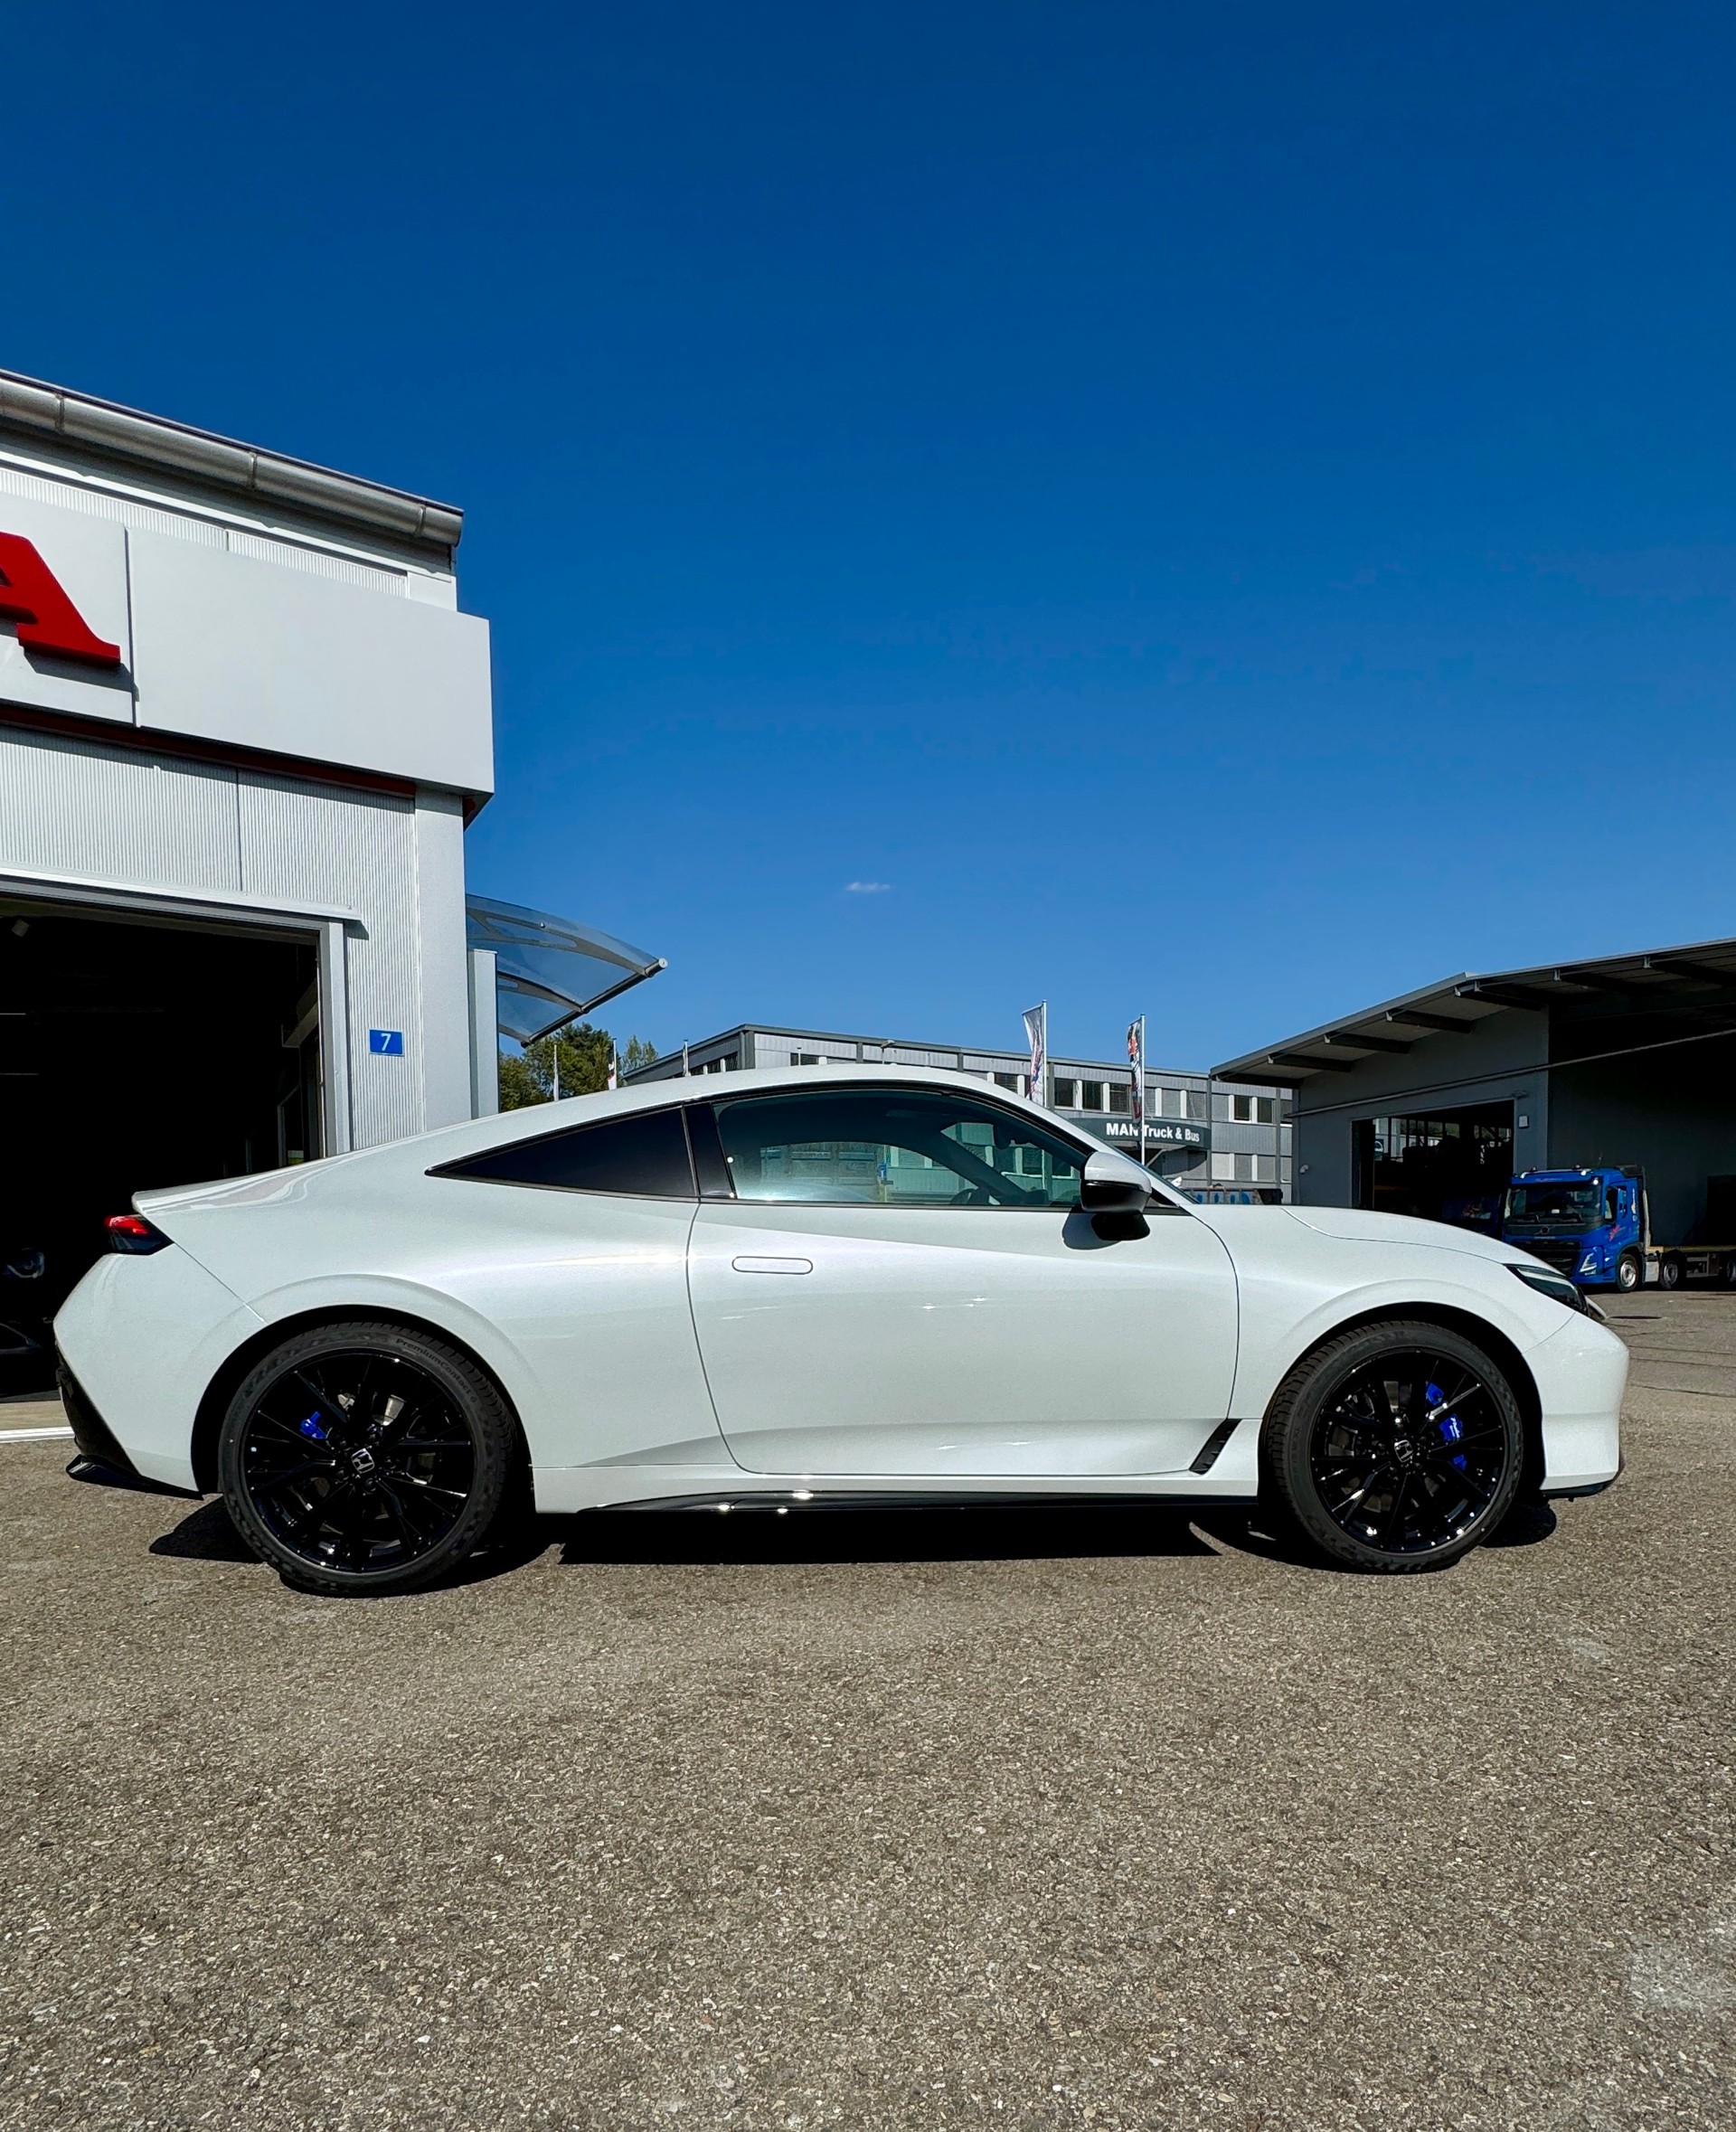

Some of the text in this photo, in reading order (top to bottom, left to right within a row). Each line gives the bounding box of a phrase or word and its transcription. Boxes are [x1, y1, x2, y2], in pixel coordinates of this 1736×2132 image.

[381, 1033, 392, 1052] 7
[1106, 1122, 1200, 1143] MAN Truck & Bus
[396, 1338, 471, 1394] PremiumContact
